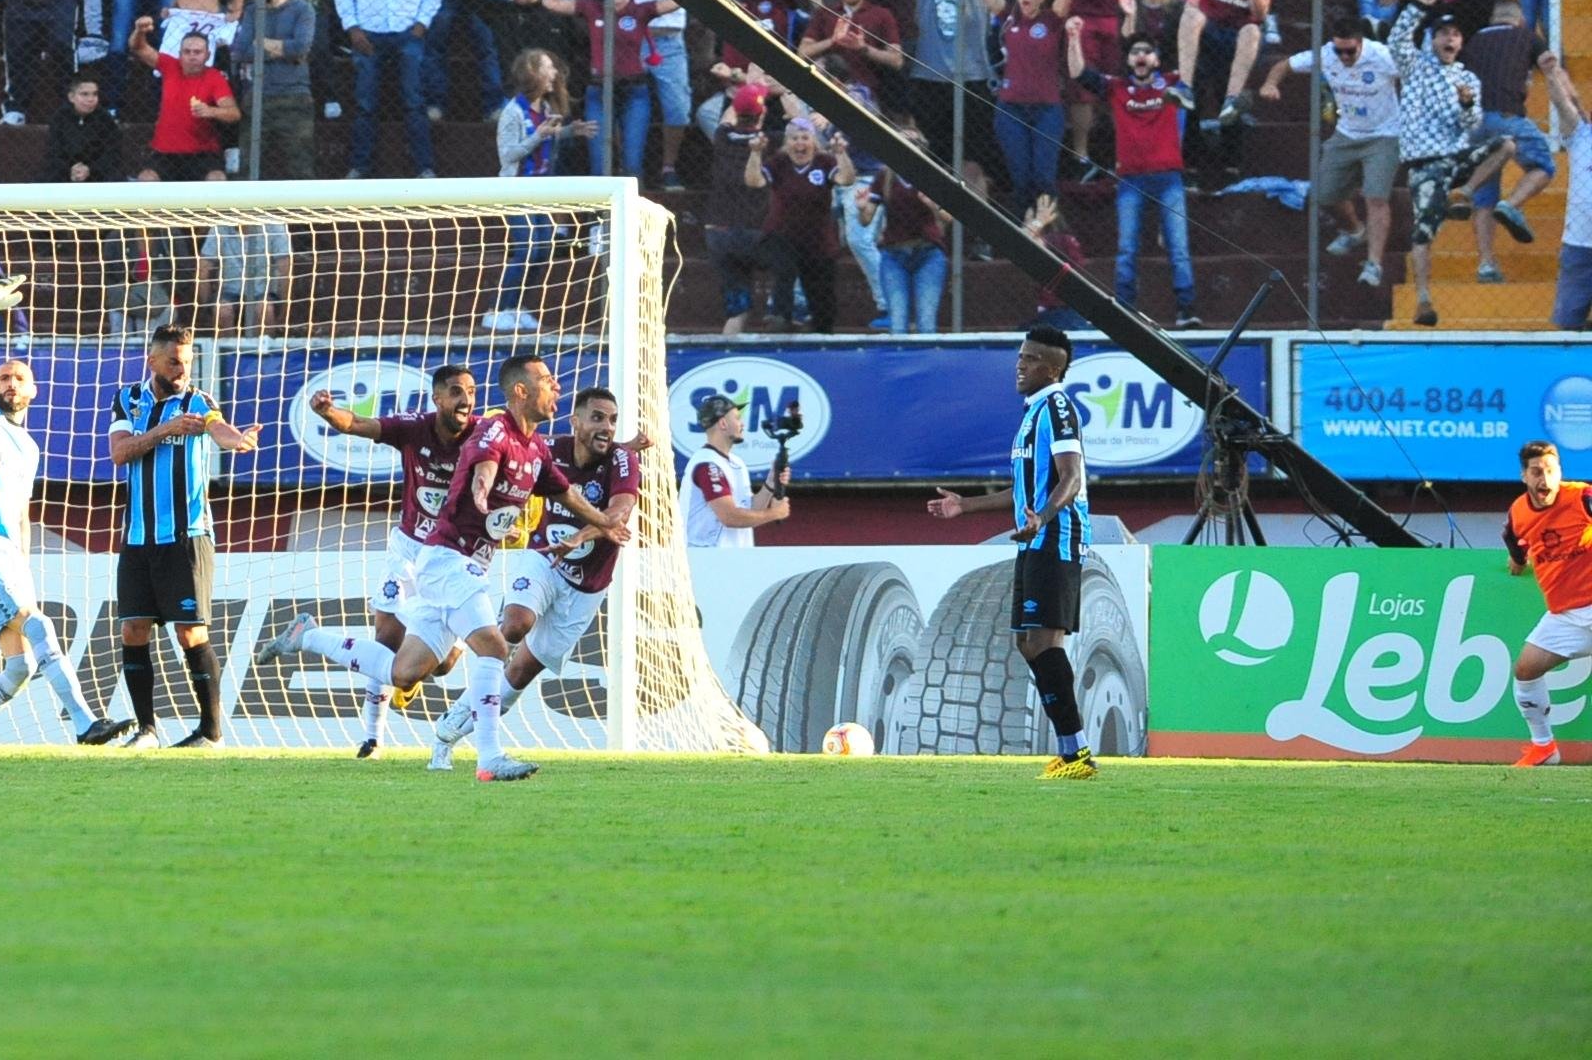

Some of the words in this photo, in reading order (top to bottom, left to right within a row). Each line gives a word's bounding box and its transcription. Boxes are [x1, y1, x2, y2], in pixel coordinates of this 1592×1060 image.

[1324, 386, 1506, 413] 4004-8844
[1323, 419, 1509, 438] WWW.NET.COM.BR
[1369, 593, 1426, 617] Lojas
